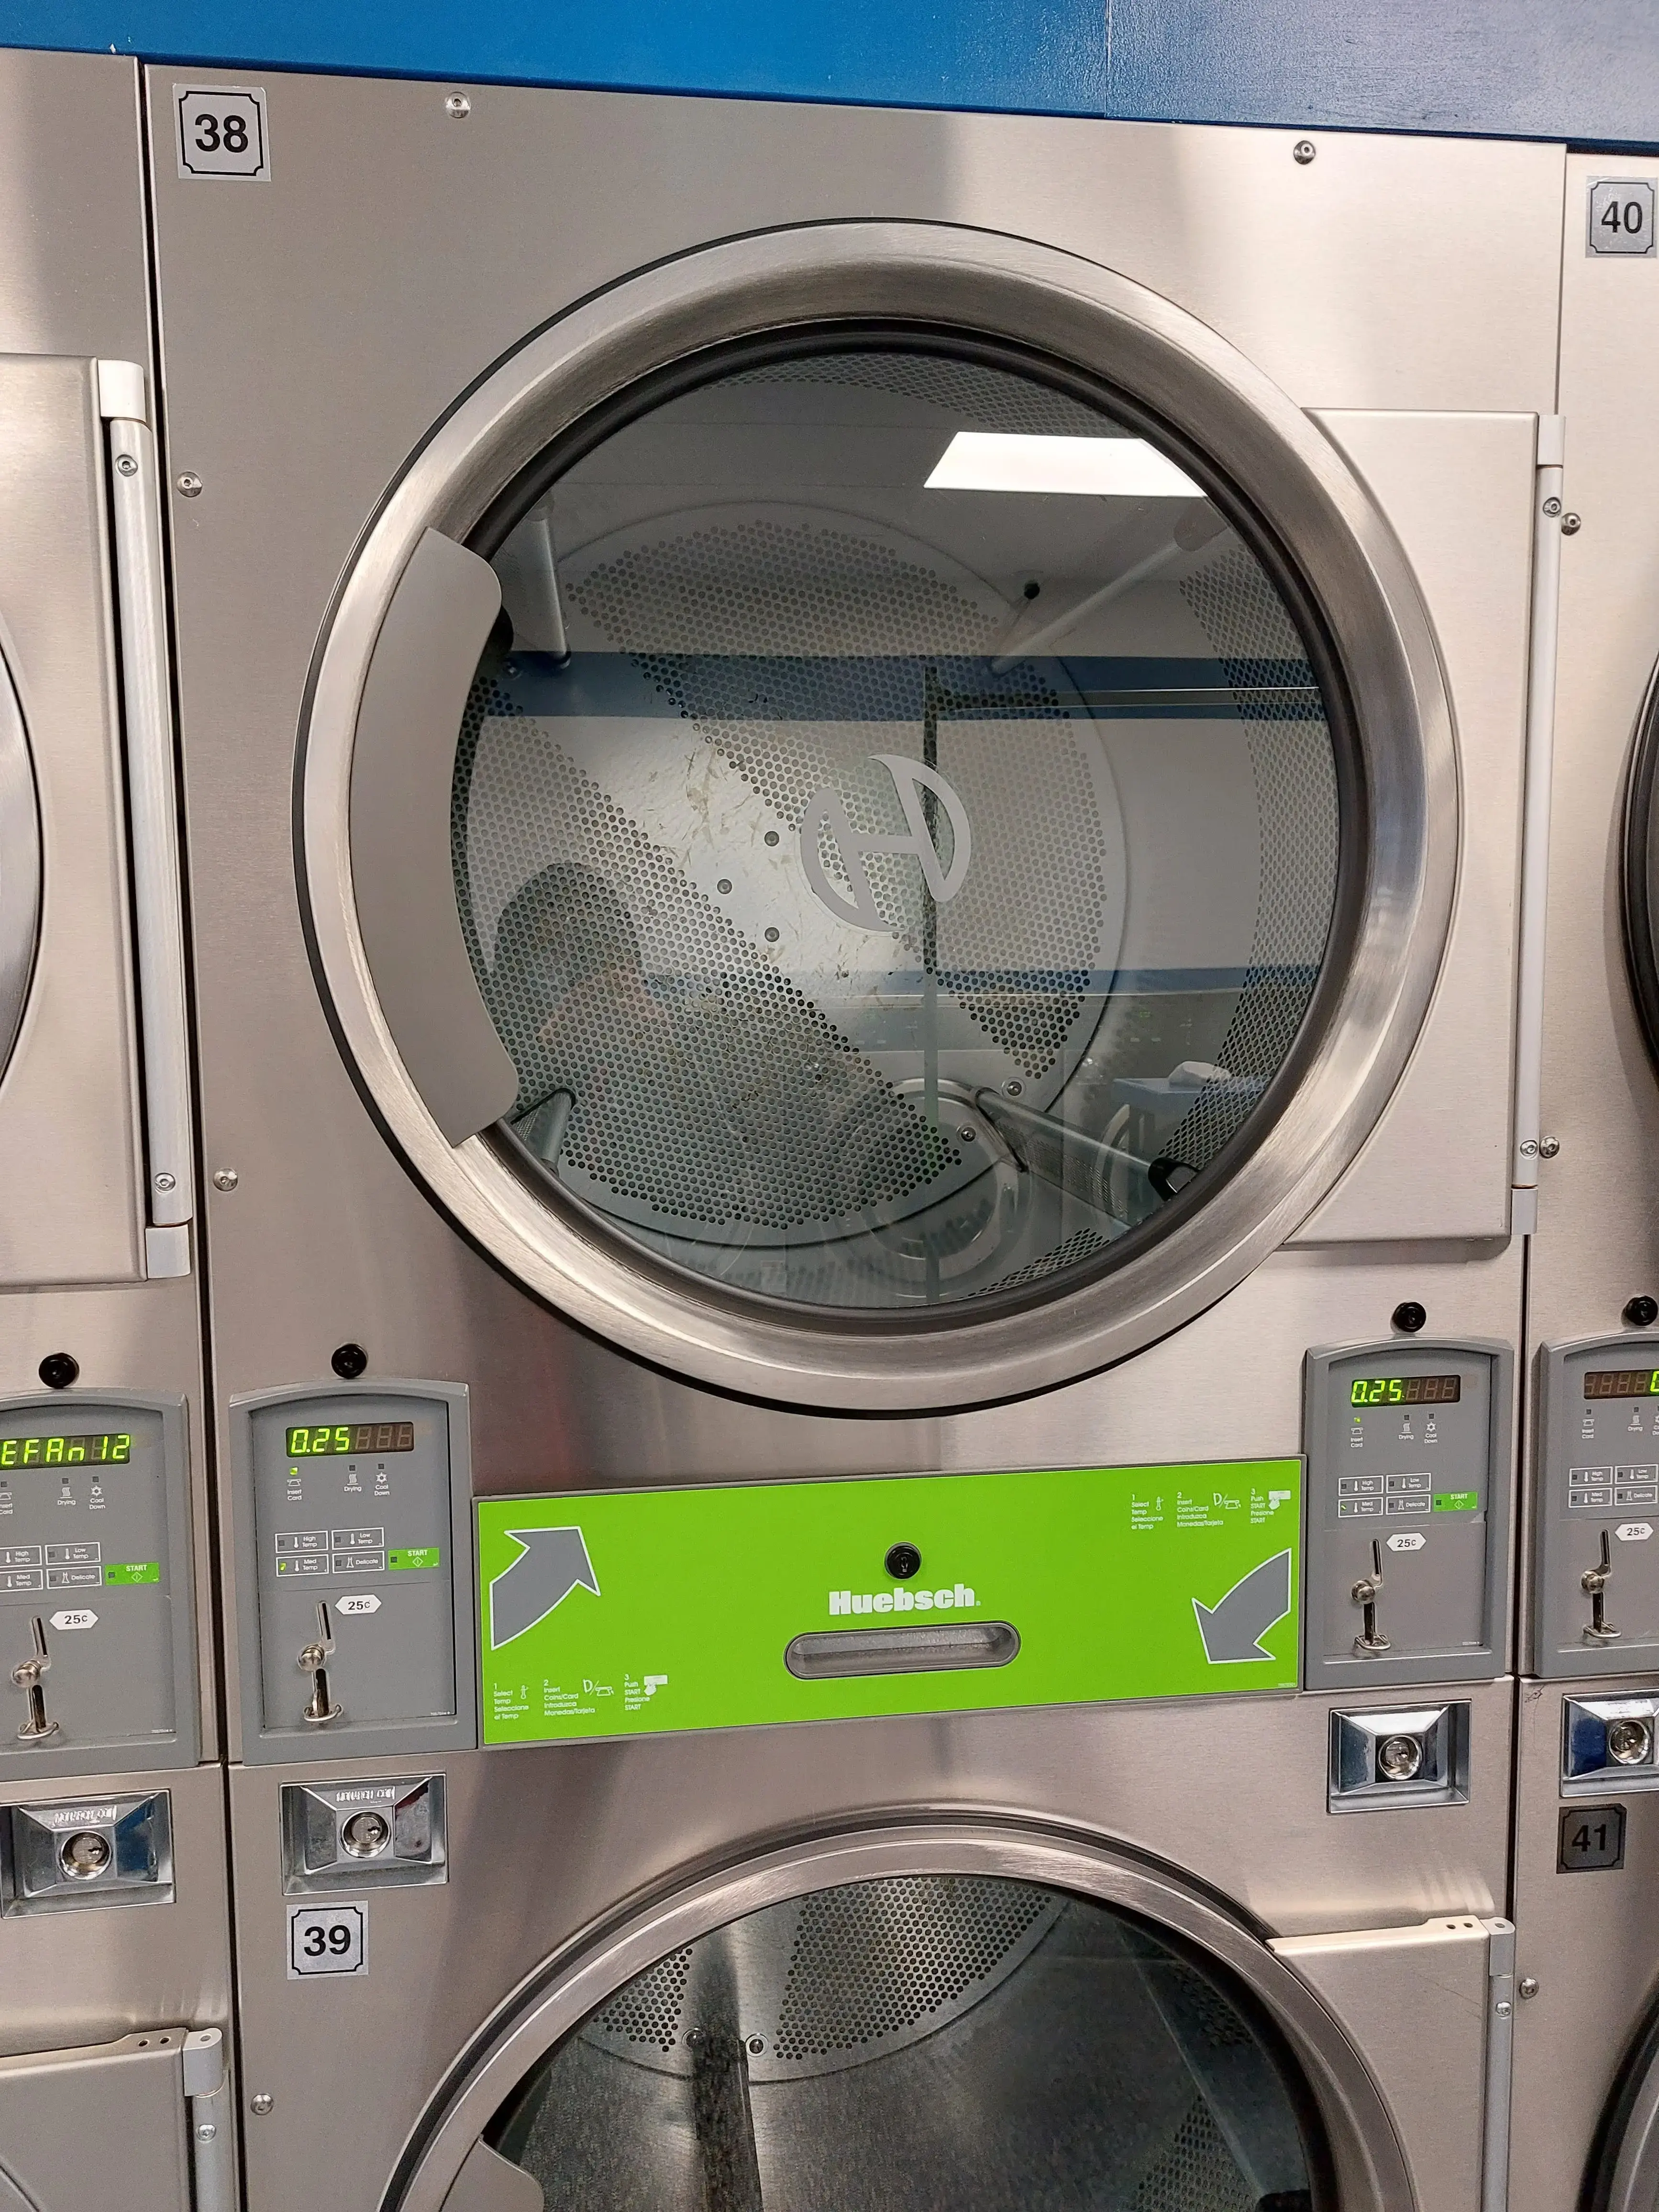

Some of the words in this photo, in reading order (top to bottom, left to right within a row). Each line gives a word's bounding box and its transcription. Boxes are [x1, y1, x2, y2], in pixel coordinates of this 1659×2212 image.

[195, 114, 248, 153] 38
[1601, 201, 1642, 234] 40
[1351, 1380, 1402, 1403] 0.25
[291, 1427, 349, 1454] 0.25
[829, 1584, 974, 1615] Huebsch
[544, 1707, 595, 1716] Monedas/Tarjeta
[1571, 1823, 1607, 1852] 41
[304, 1924, 351, 1956] 39
